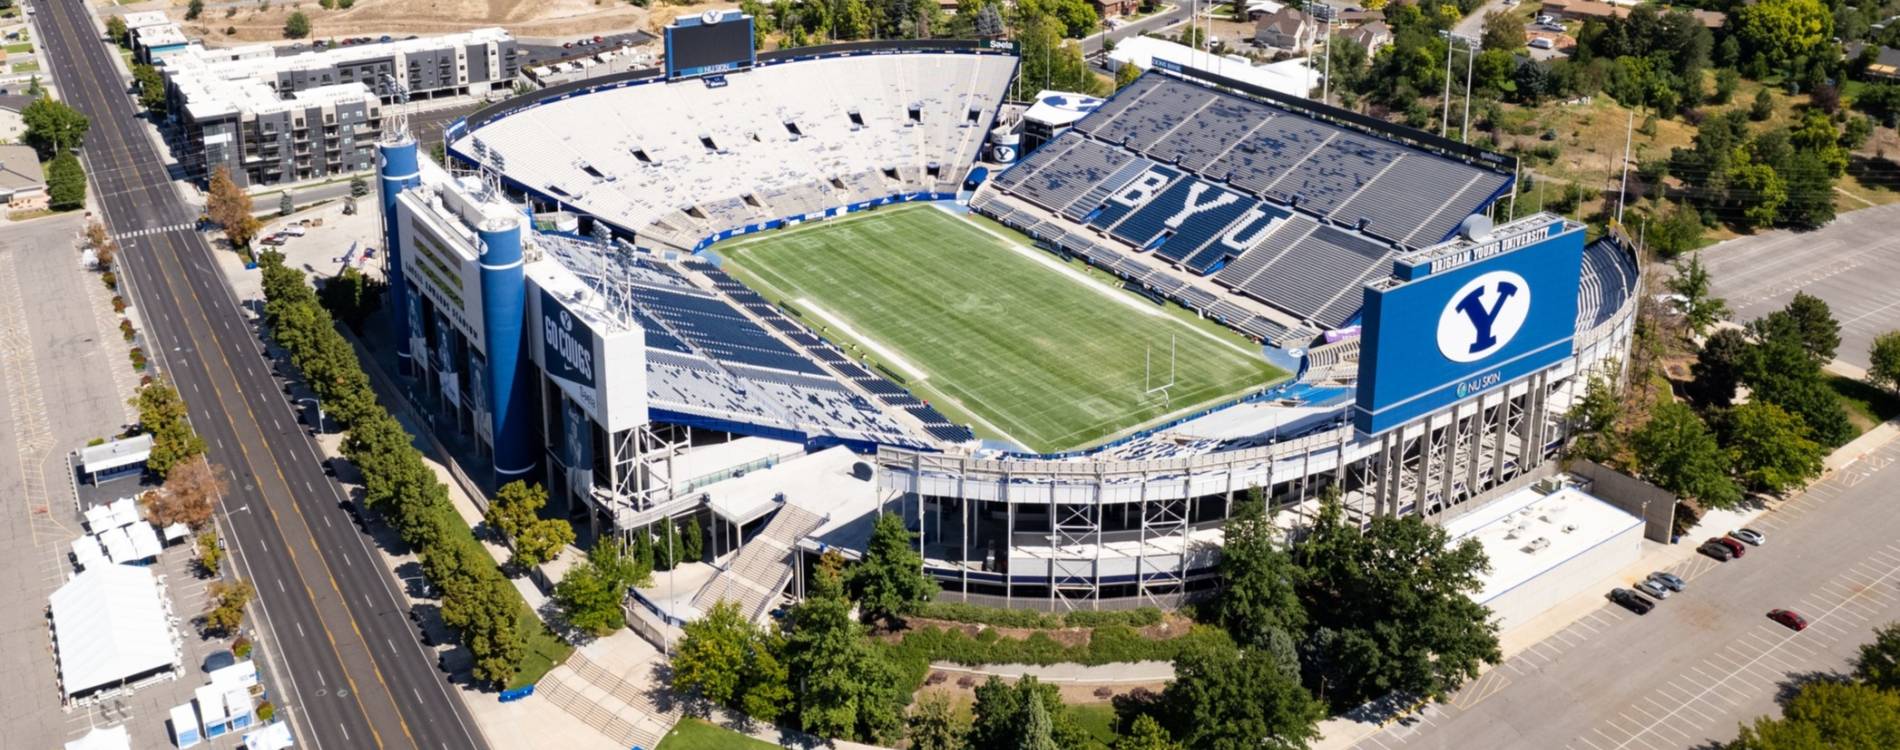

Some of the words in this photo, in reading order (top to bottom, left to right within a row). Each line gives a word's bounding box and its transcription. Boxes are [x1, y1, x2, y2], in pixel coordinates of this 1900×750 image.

[1110, 170, 1286, 251] BYU
[1431, 250, 1471, 274] BRIGHAM
[1473, 241, 1500, 261] YOUNG
[1501, 227, 1550, 252] UNIVERSITY
[545, 315, 558, 351] GO
[559, 327, 592, 381] COUGS
[1455, 281, 1518, 354] Y
[1468, 378, 1481, 394] NU
[1482, 370, 1501, 389] SKIN
